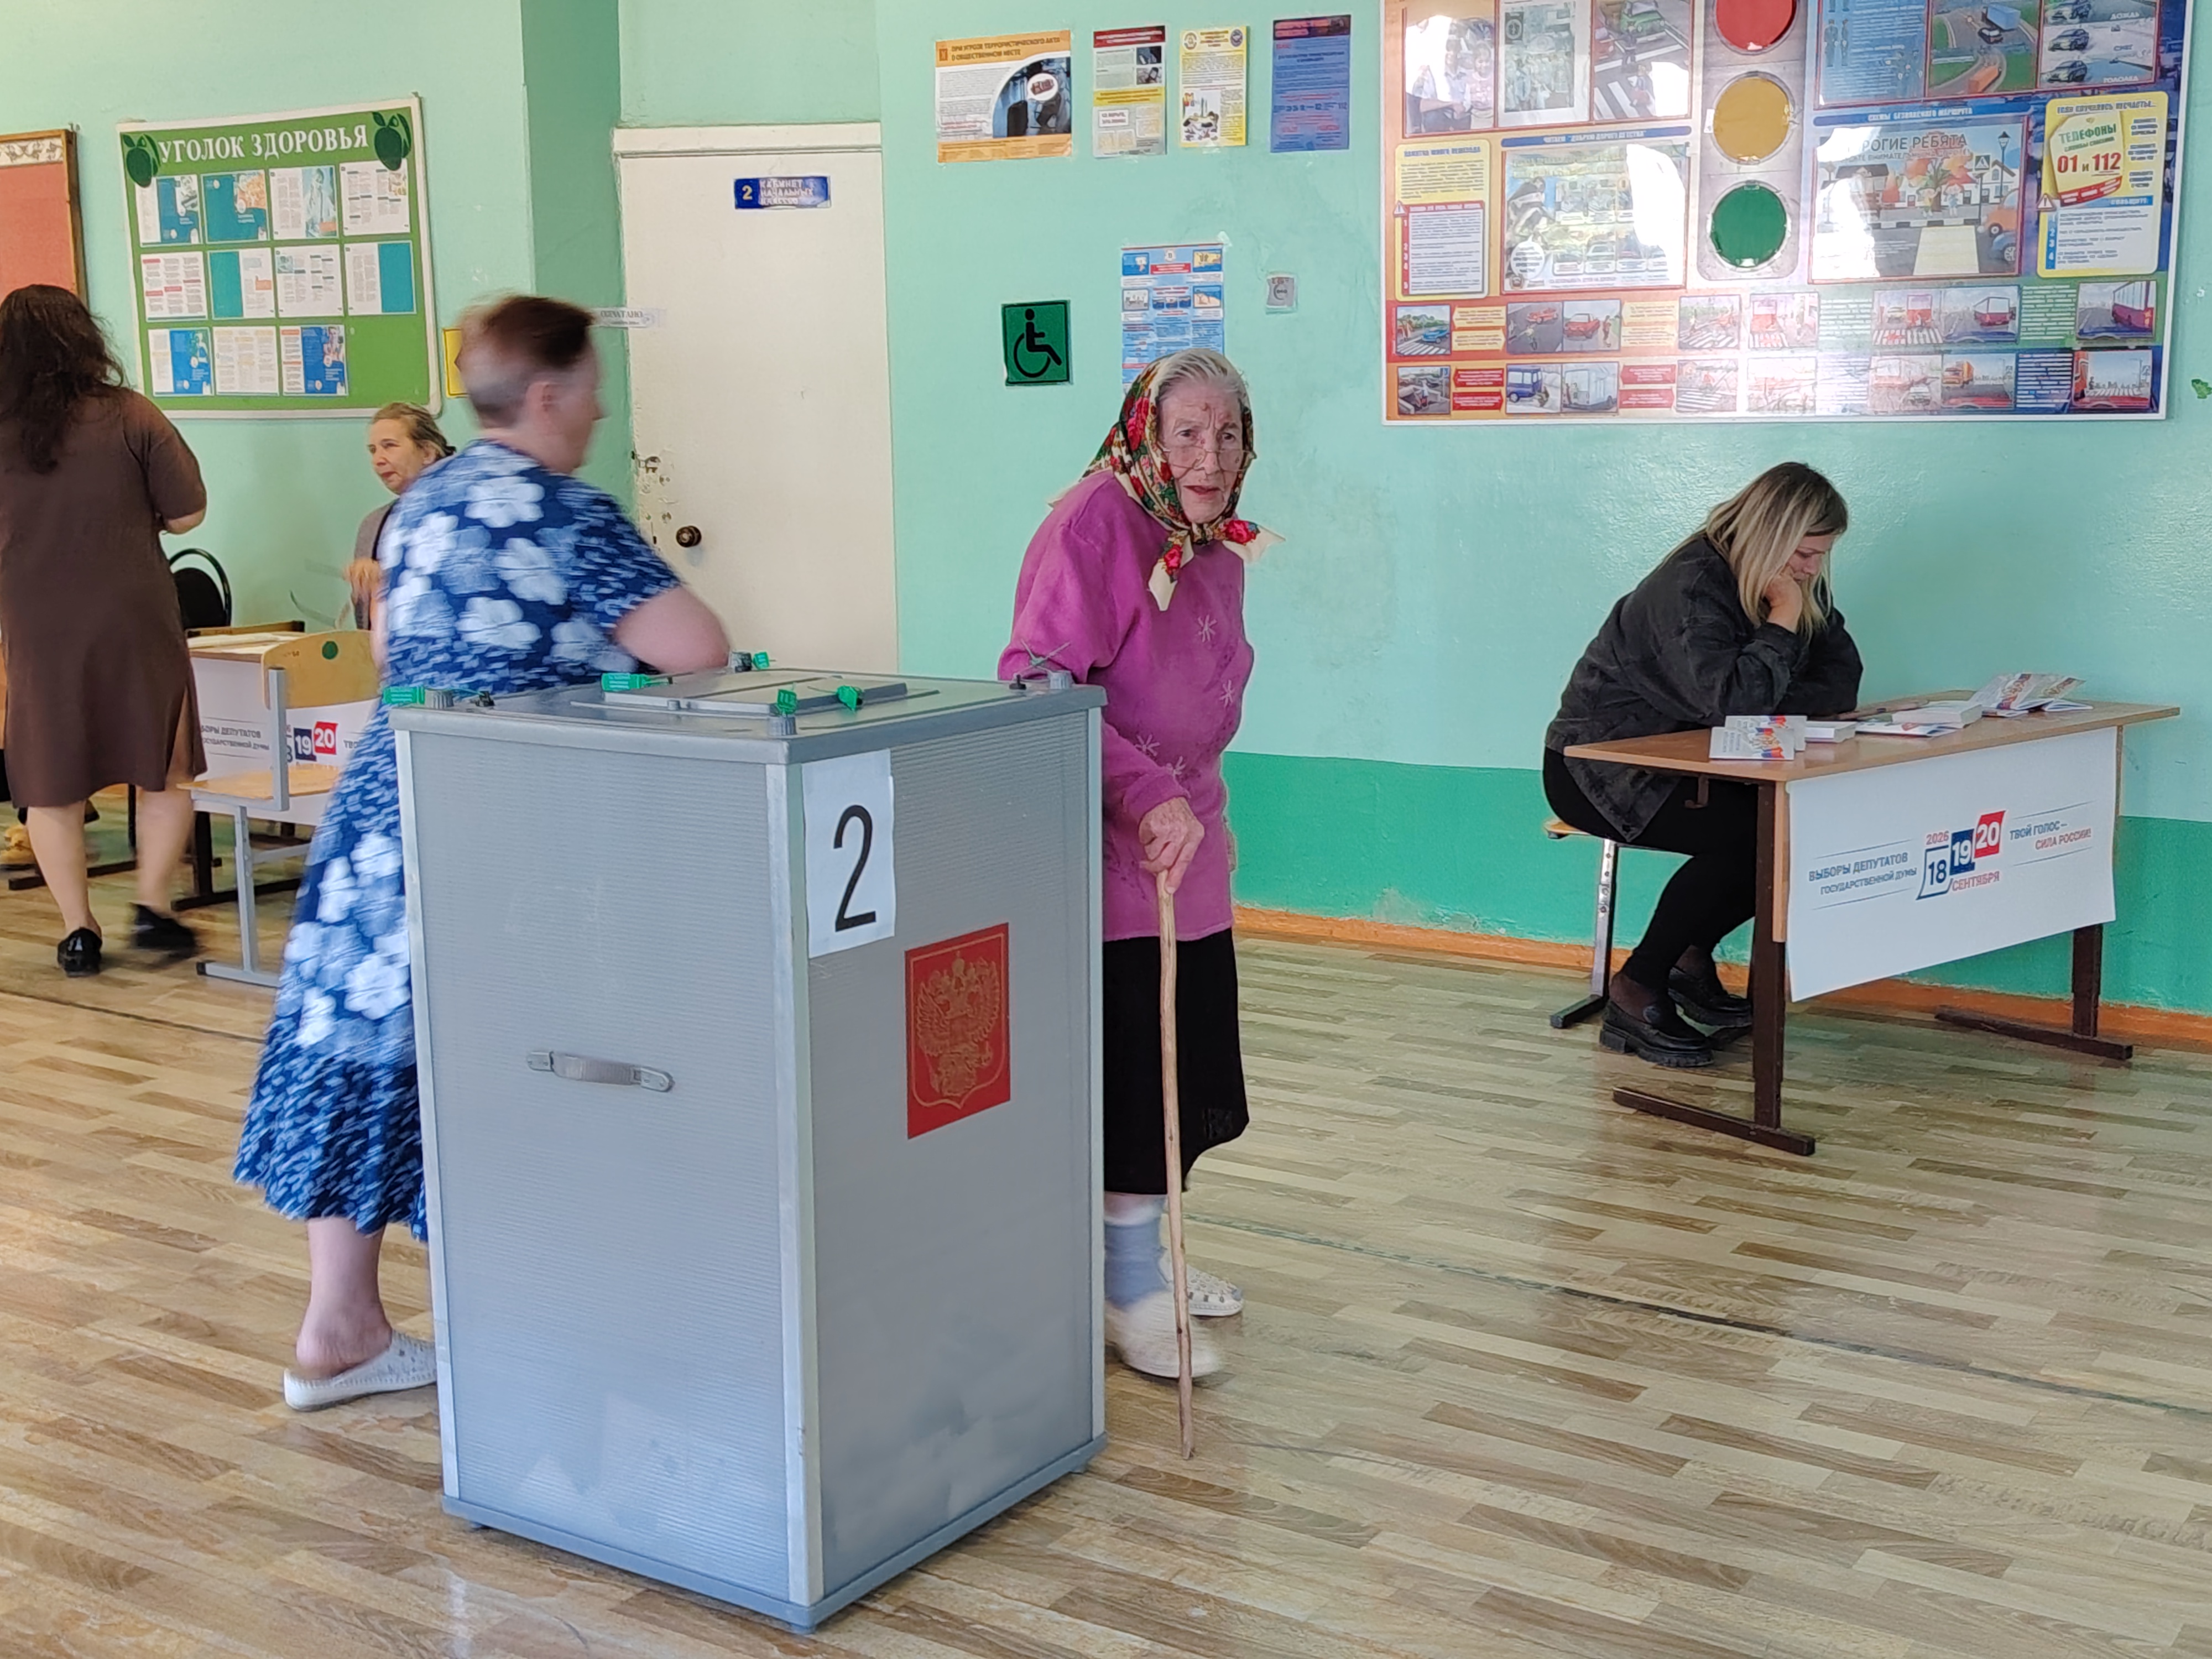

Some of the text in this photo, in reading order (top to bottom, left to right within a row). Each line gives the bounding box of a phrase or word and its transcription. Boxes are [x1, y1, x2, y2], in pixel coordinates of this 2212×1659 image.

[158, 124, 369, 164] УГОЛОК ЗДОРОВЬЯ
[1912, 134, 1968, 149] РЕБЯТА
[2058, 123, 2117, 144] ТЕЛЕФОНЫ
[2057, 154, 2078, 174] 01
[2091, 152, 2121, 171] 112
[742, 185, 753, 200] 2
[760, 179, 804, 187] КАБИНЕТ
[221, 727, 261, 739] ДЕПУТАТОВ
[295, 728, 335, 756] 19 20
[1926, 830, 1949, 846] 2026
[1976, 821, 2001, 849] 20
[2010, 823, 2032, 840] ТВОЙ
[2033, 821, 2060, 836] ГОЛОС
[2035, 828, 2091, 850] СИЛА РОССИИ!
[1952, 839, 1972, 867] 19
[833, 804, 877, 932] 2
[1809, 852, 1908, 881] ВЫБОРЫ ДЕПУТАТОВ
[1928, 859, 1947, 885] 18
[1820, 868, 1917, 895] ГОСУДАРСТВЕННОЙ ДУМЫ
[1952, 871, 2000, 891] СЕНТЯБРЯ
